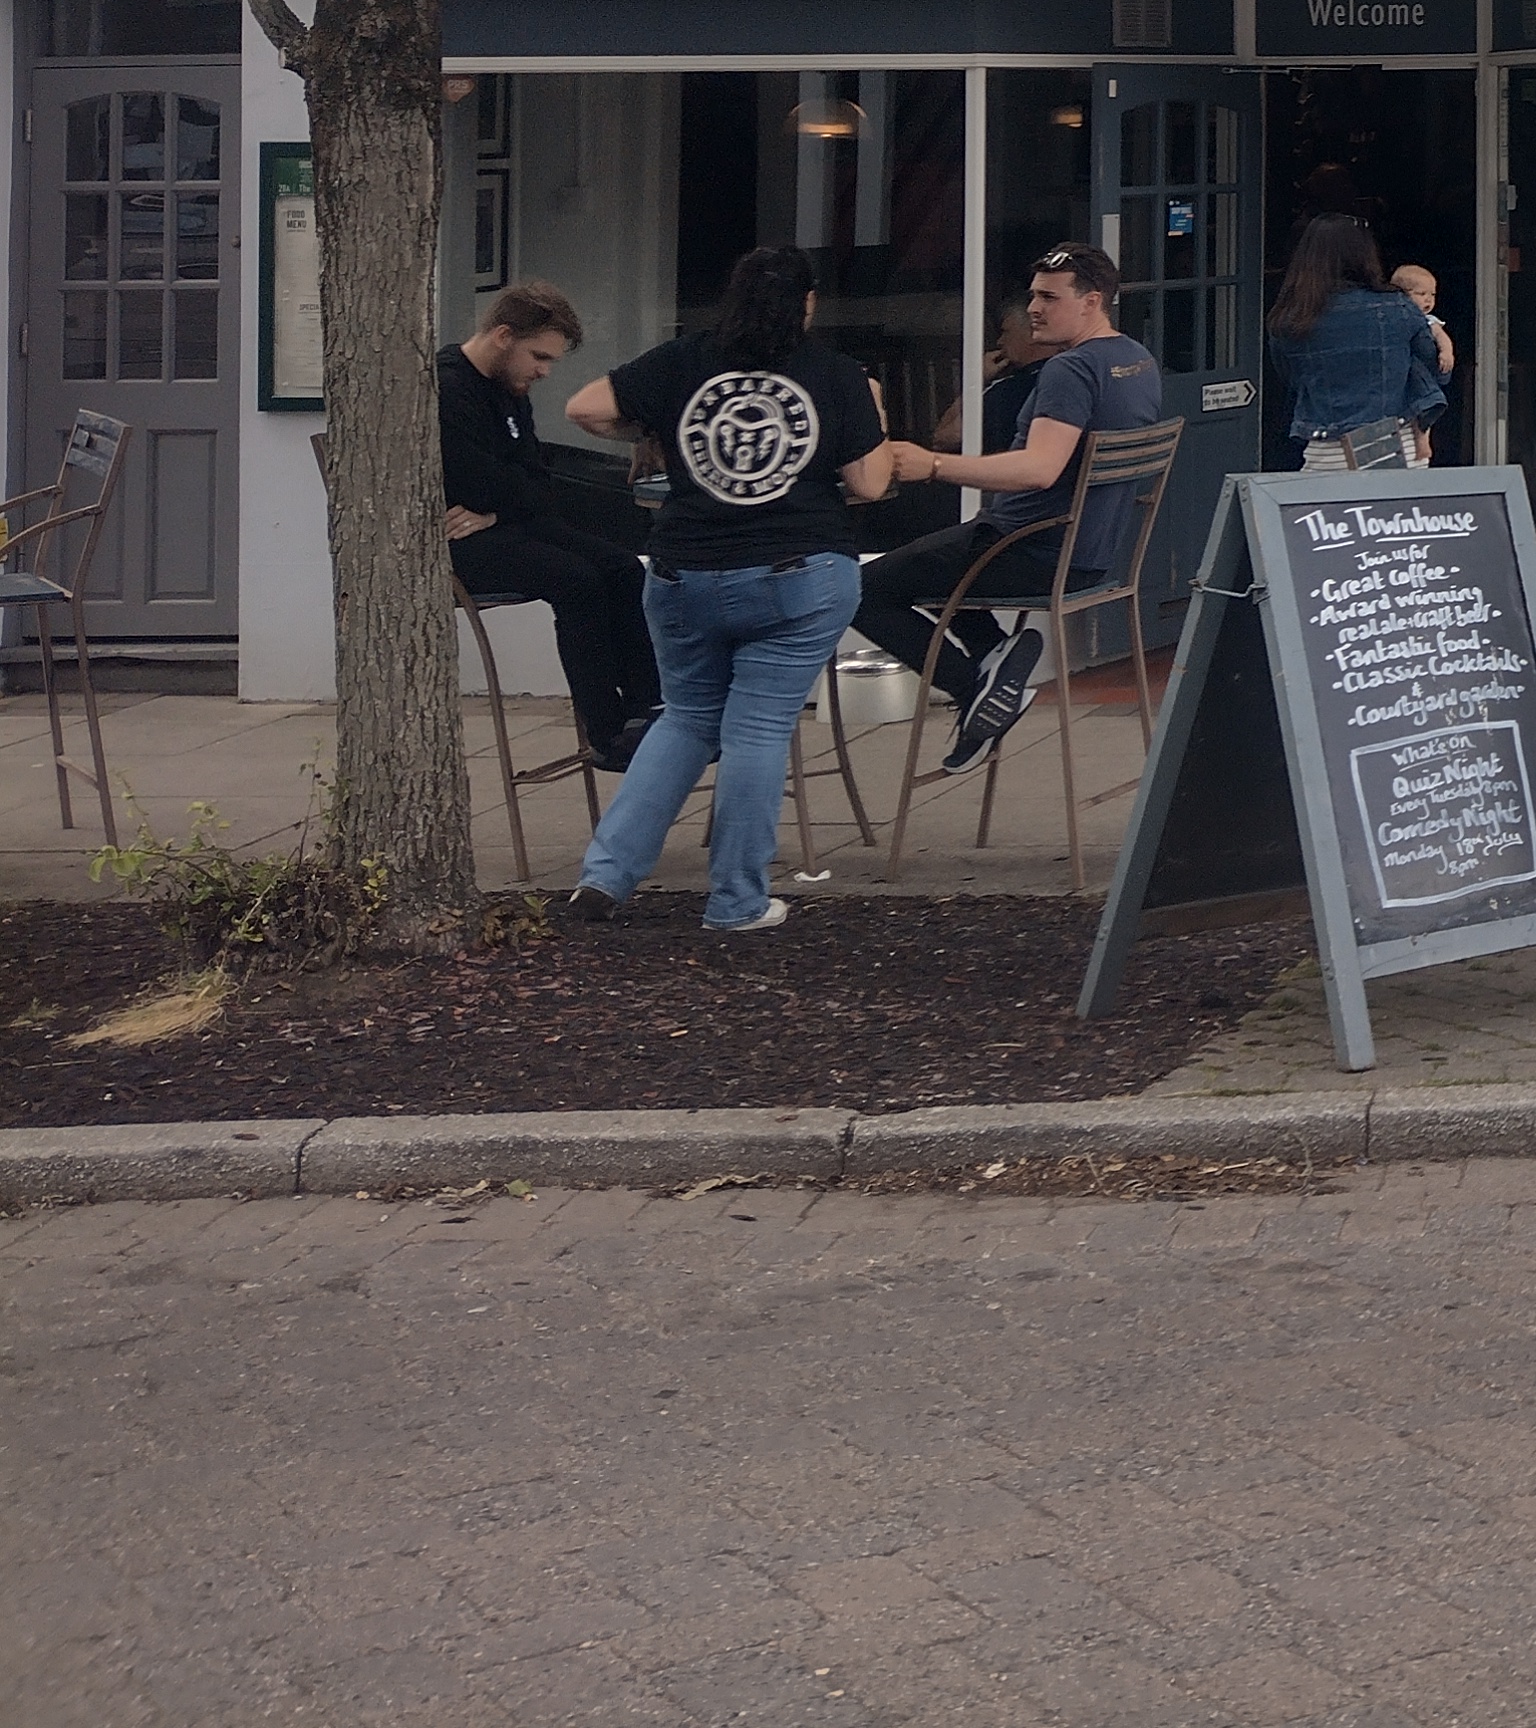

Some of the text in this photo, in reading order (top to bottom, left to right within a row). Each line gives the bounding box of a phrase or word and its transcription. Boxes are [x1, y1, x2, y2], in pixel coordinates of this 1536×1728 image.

[1294, 506, 1478, 541] The Townhouse
[1354, 551, 1391, 570] Join
[1409, 544, 1431, 562] for
[1322, 570, 1386, 602] Great
[1319, 585, 1483, 626] Award winning
[1334, 629, 1481, 671] Fantastic food
[1354, 687, 1457, 727] Courtyard
[1391, 737, 1447, 766] What's
[1392, 752, 1504, 799] Quiz Night
[1378, 799, 1522, 847] Comedy Night
[1383, 843, 1449, 875] Monday
